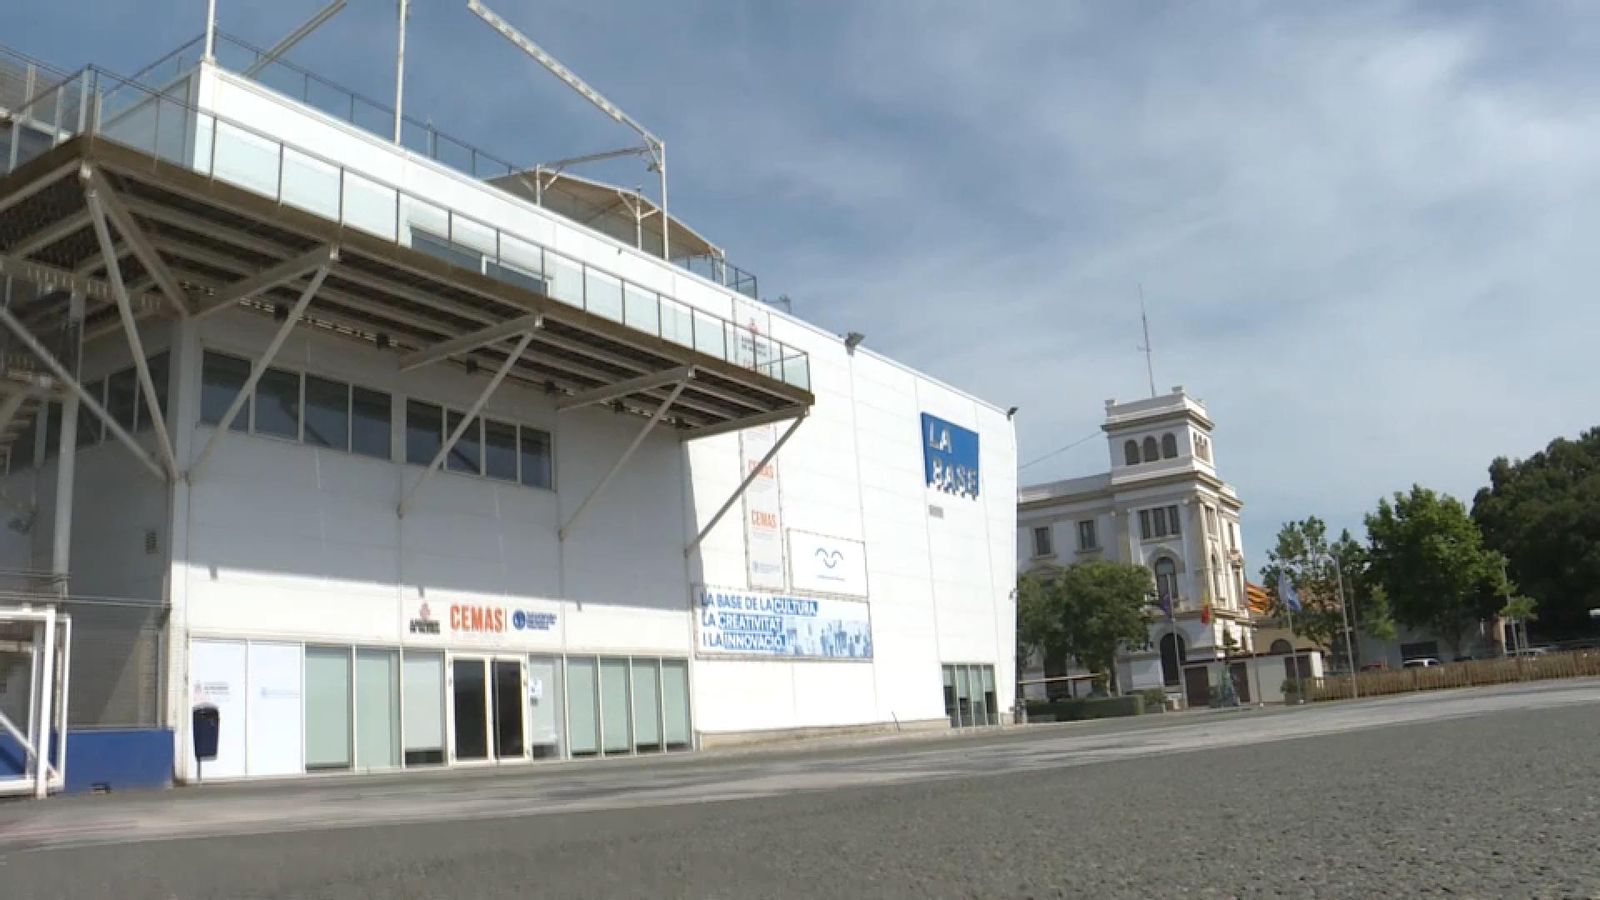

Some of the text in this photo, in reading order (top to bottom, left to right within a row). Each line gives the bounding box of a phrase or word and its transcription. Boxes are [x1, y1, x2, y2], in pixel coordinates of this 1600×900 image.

[930, 421, 952, 454] LA
[932, 456, 978, 500] BASE
[751, 509, 777, 529] CEMAS
[701, 592, 714, 608] LA
[717, 593, 742, 609] BASE
[745, 596, 757, 610] DE
[760, 597, 772, 611] LA
[450, 603, 503, 634] CEMAS
[702, 610, 782, 632] LA CREATIVITAT
[709, 632, 723, 647] LA
